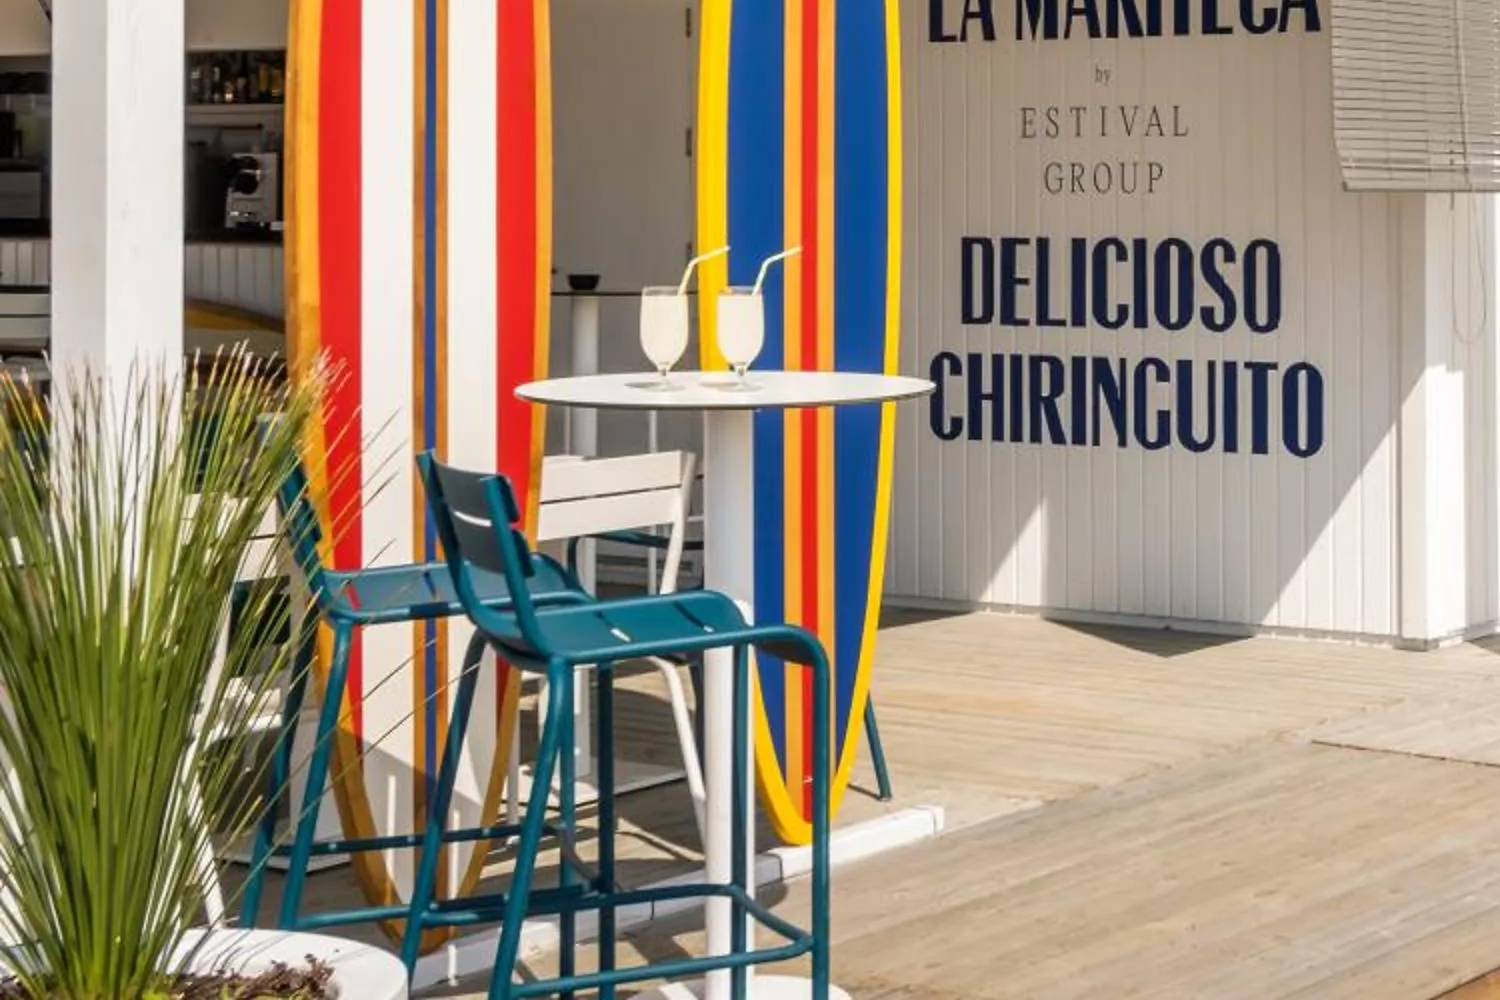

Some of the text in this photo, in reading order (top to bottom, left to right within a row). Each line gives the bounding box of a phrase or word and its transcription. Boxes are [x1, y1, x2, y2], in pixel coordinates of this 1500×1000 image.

[1094, 64, 1112, 87] by
[1019, 105, 1190, 140] ESTIVAL
[1043, 161, 1165, 195] GROUP
[960, 236, 1282, 335] DELICIOSO
[929, 351, 1324, 459] CHIRINGUITO
